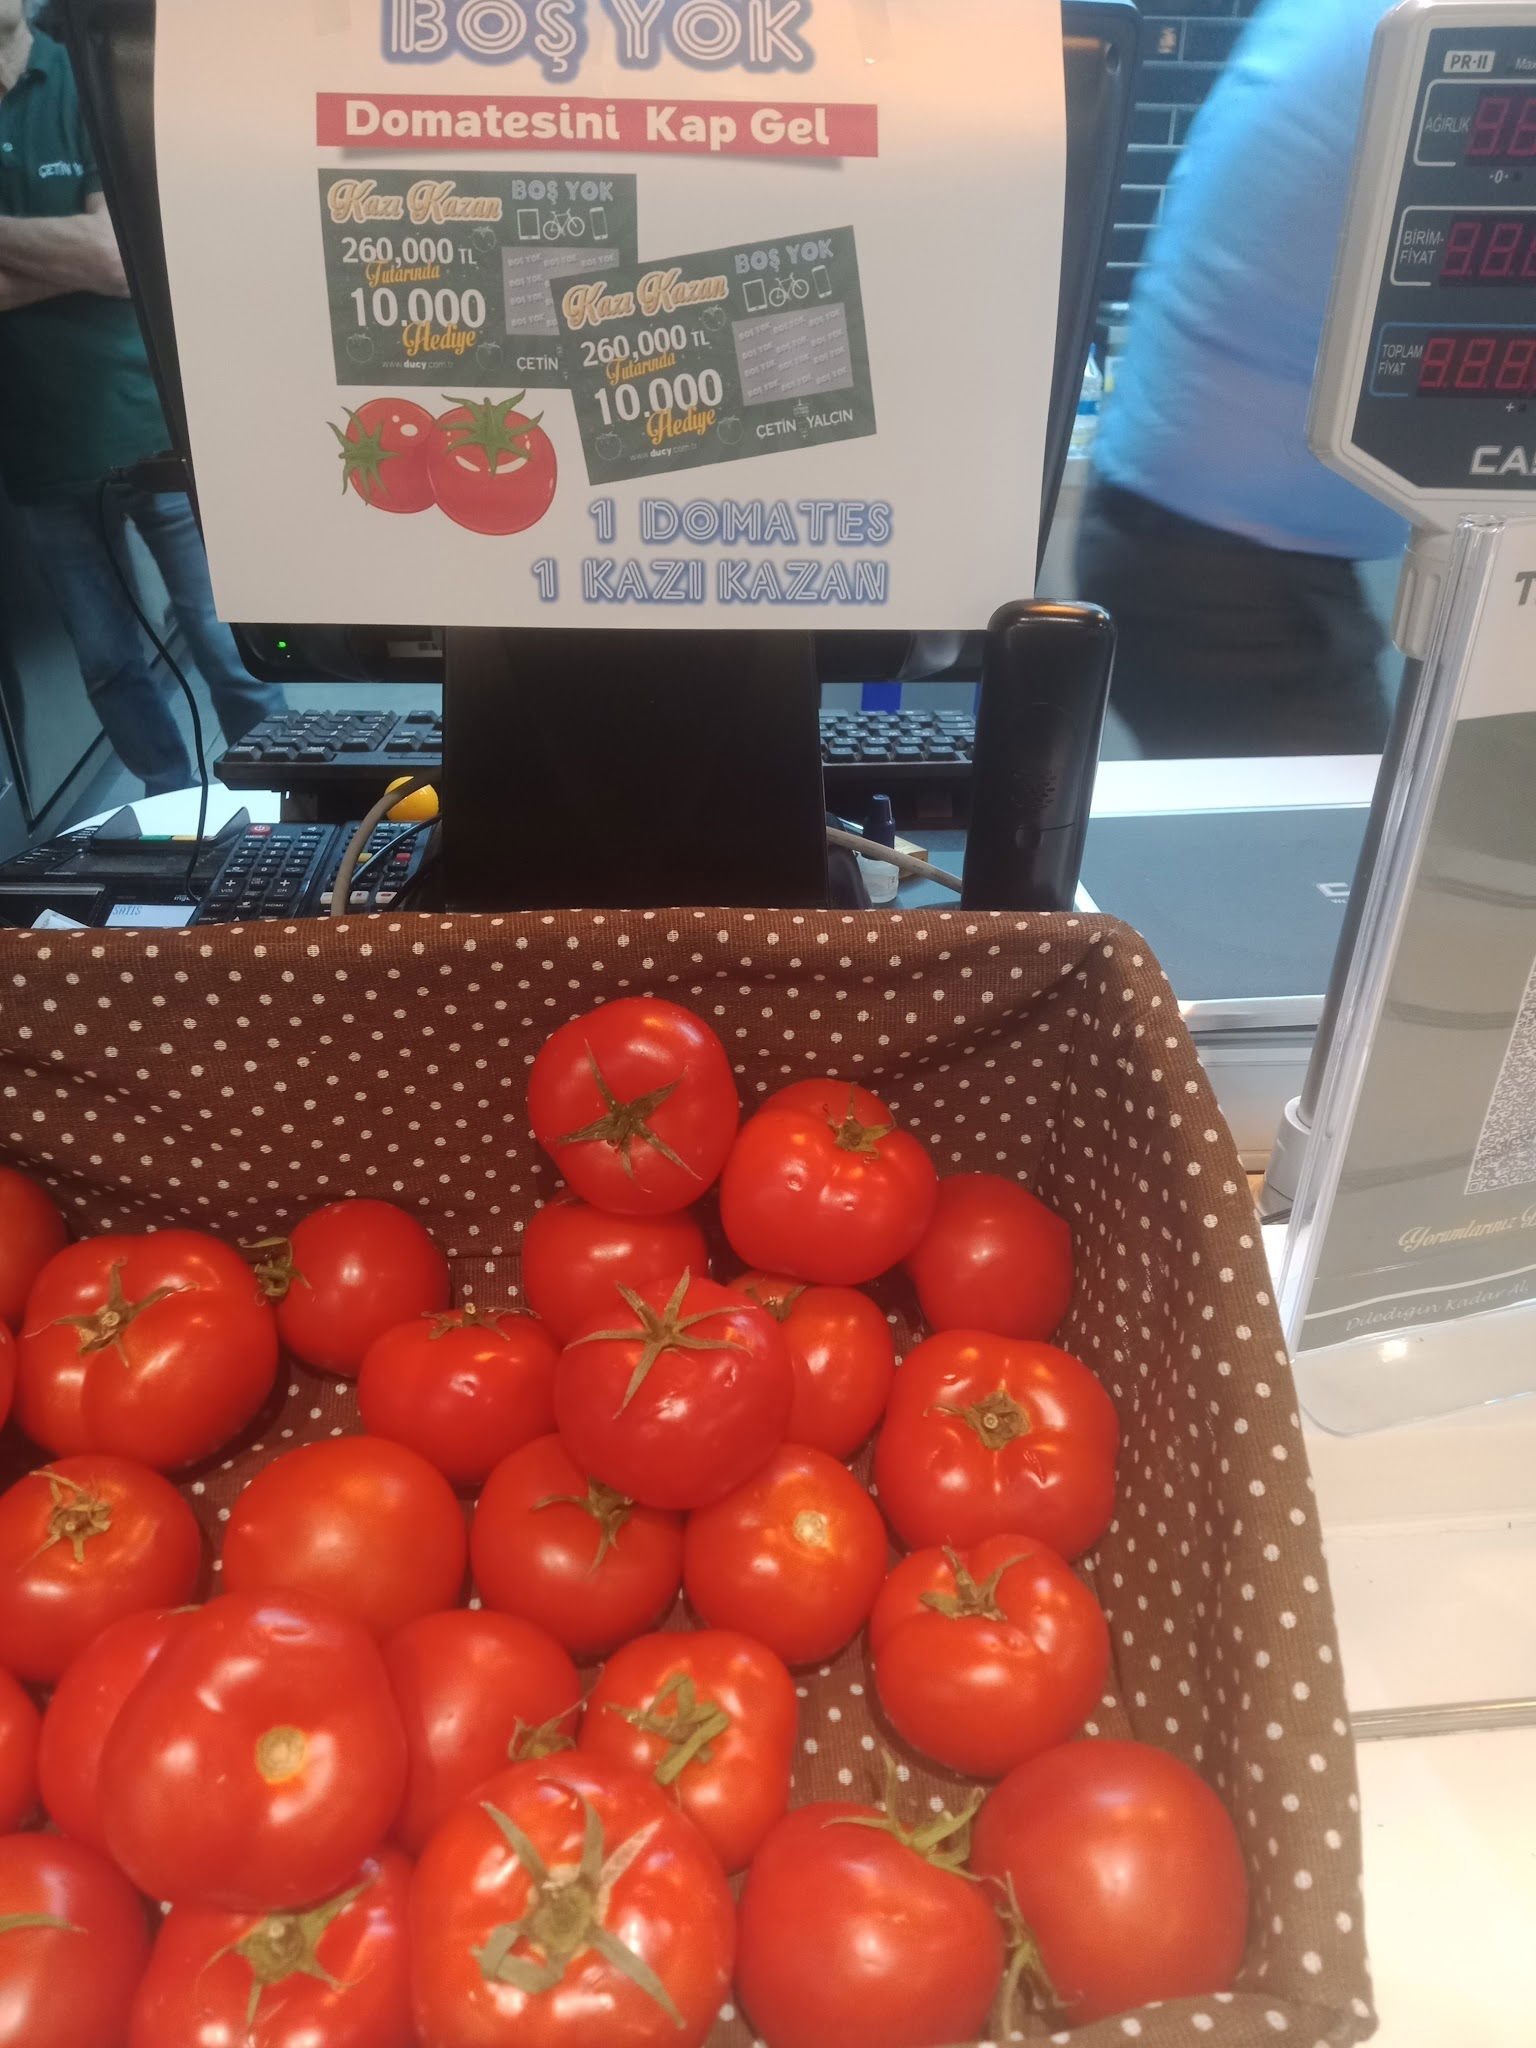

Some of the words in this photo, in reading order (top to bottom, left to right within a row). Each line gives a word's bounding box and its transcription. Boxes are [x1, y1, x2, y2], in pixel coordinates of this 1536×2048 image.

[386, 0, 583, 80] BOŞ
[614, 0, 811, 68] YOK
[1450, 54, 1488, 70] PR-II
[346, 99, 620, 141] Domatesini
[646, 105, 737, 151] Kap
[750, 107, 830, 145] Gel
[1425, 114, 1471, 132] AĞIRLIK
[328, 179, 403, 223] Kazı
[407, 179, 502, 224] Kazan
[512, 180, 558, 205] BOŞ
[565, 180, 613, 201] YOK
[341, 237, 454, 268] 260,000
[458, 249, 477, 265] TL
[735, 248, 780, 274] BOŞ
[785, 238, 834, 264] YOK
[1400, 249, 1436, 264] FİYAT
[366, 260, 440, 288] Tutarında
[351, 287, 486, 329] 10.000
[562, 281, 635, 330] Kazı
[637, 268, 729, 317] Kazan
[402, 320, 476, 357] Hediye
[580, 325, 687, 367] 260,000
[691, 330, 710, 347] TL
[1382, 344, 1423, 358] TOPLAM
[516, 354, 558, 372] ÇETİN
[606, 352, 676, 385] Tutarında
[1378, 361, 1406, 375] FİYAT
[595, 369, 723, 425] 10.000
[647, 406, 716, 445] Hediye
[756, 418, 797, 439] ÇETİN
[589, 499, 614, 541] 1
[642, 499, 892, 542] DOMATES
[532, 558, 555, 600] 1
[583, 558, 703, 600] KAZI
[718, 559, 886, 601] KAZAN
